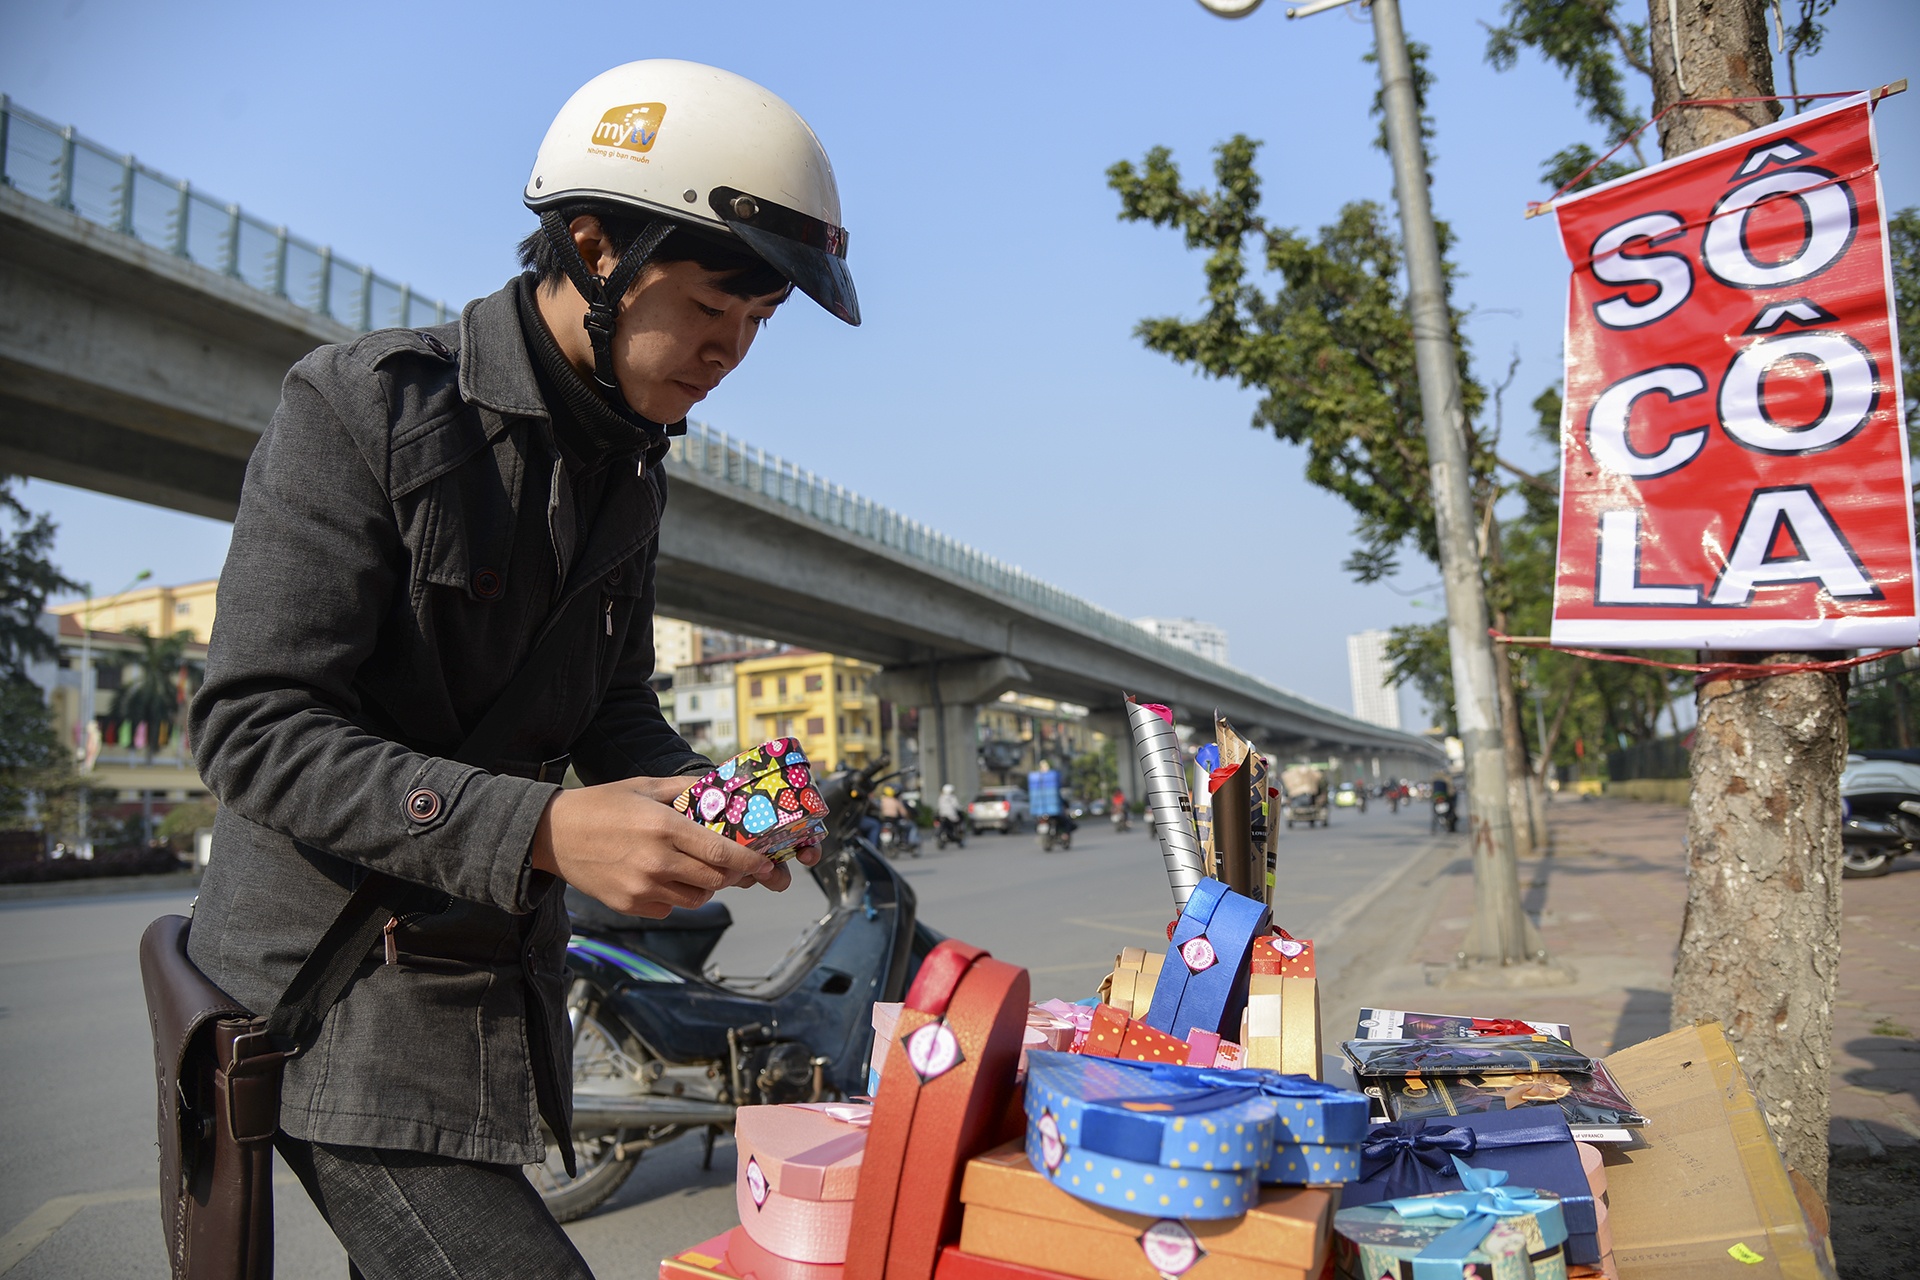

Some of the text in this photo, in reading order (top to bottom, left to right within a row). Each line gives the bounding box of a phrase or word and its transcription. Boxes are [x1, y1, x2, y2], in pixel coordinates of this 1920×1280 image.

[596, 122, 656, 146] mytv
[1589, 137, 1860, 331] SÔ
[1585, 297, 1881, 481] CÔ
[1594, 483, 1886, 609] LA
